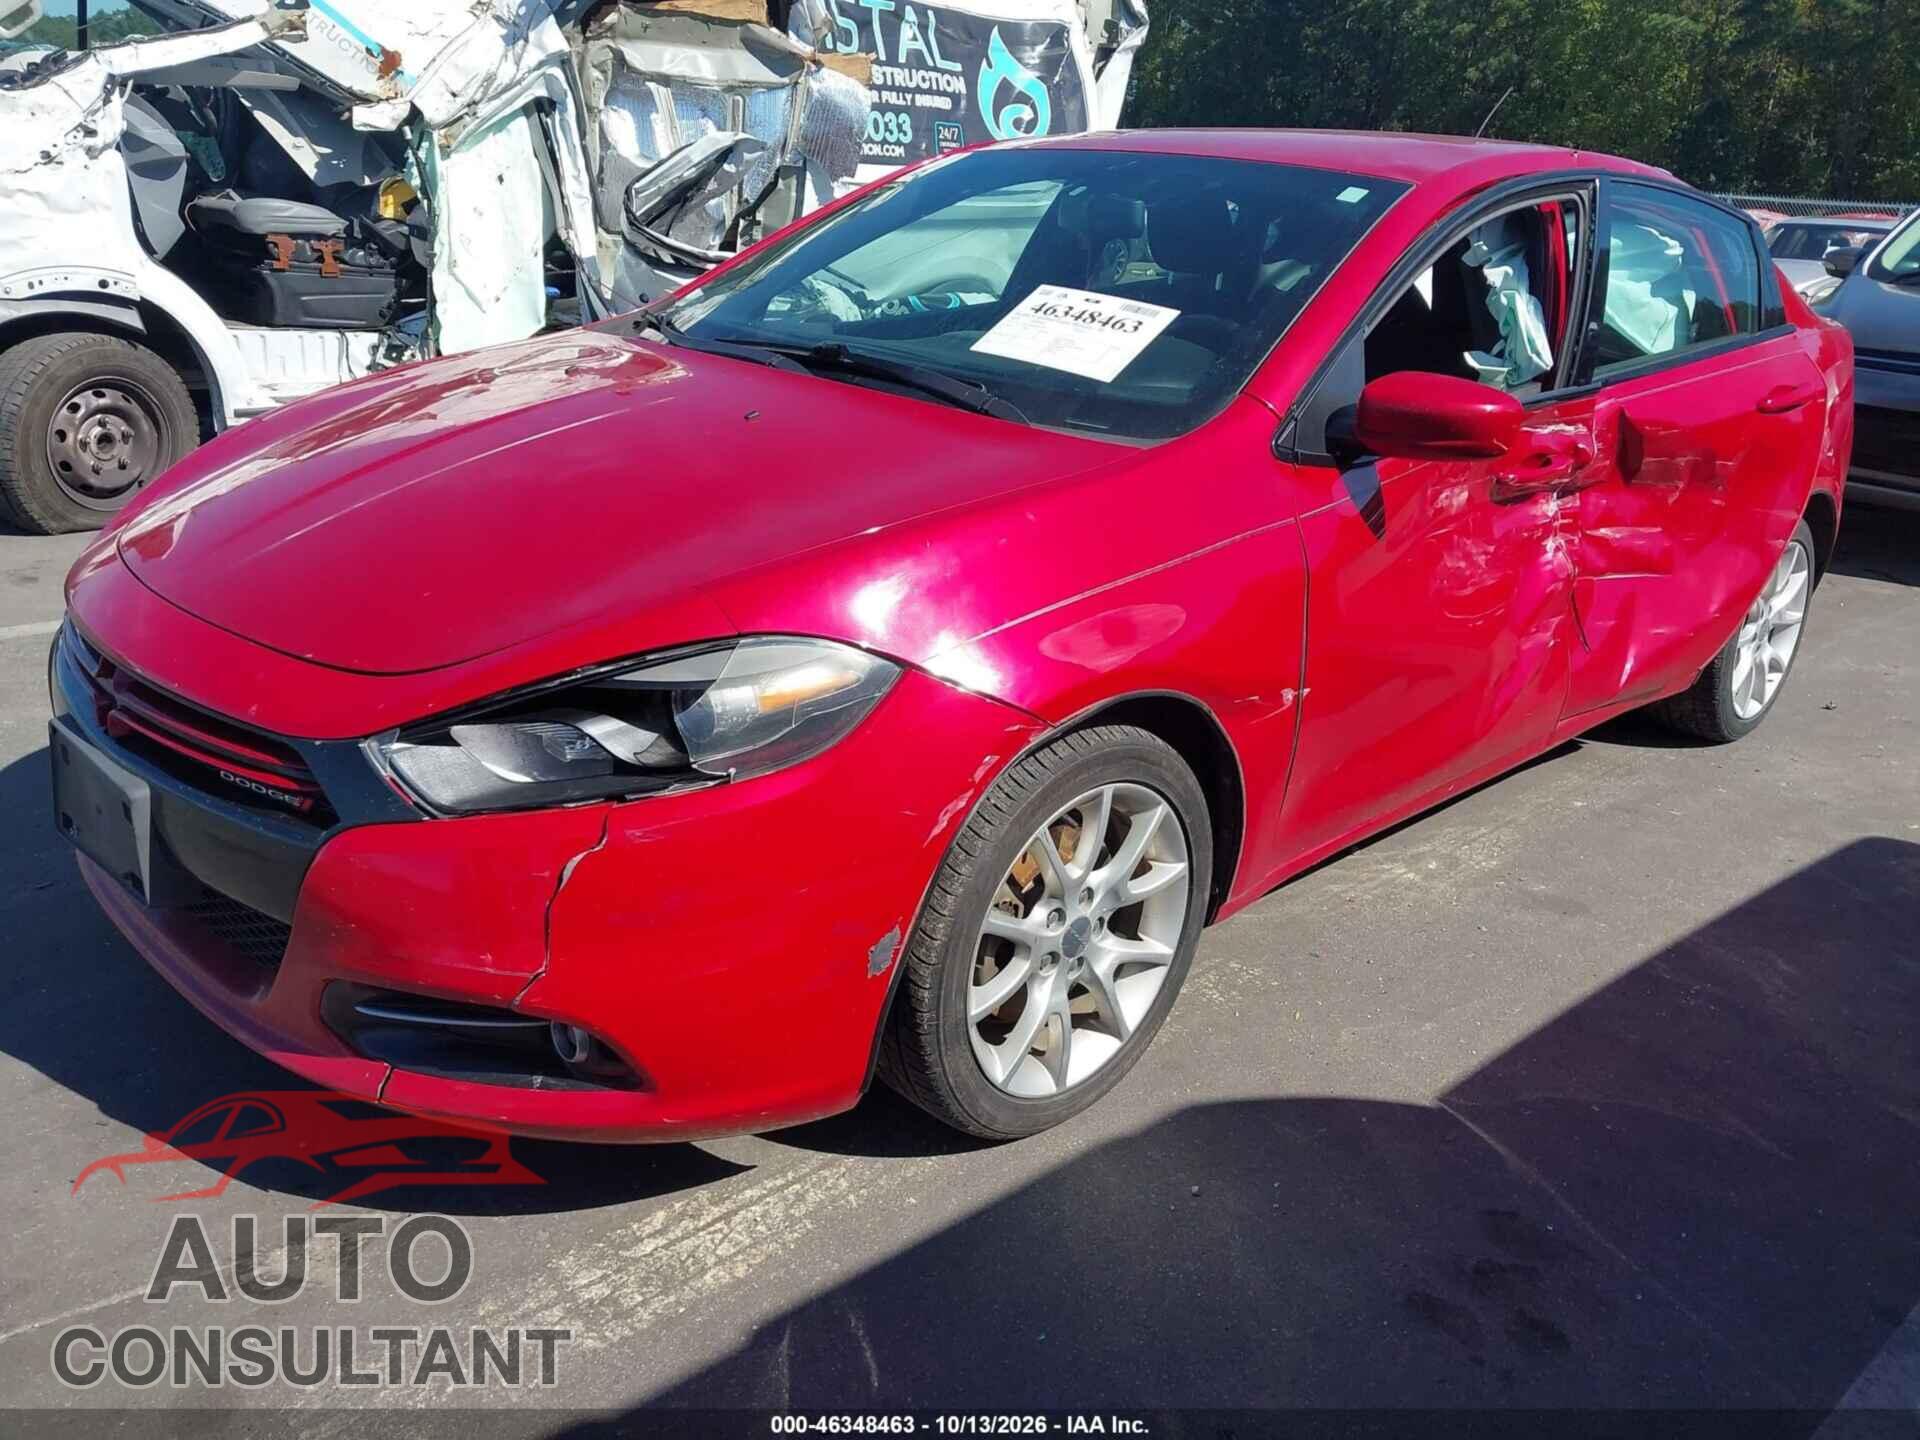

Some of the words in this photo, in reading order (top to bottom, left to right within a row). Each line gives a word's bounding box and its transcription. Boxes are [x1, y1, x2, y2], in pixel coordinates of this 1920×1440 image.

[881, 90, 913, 106] FULLY
[938, 126, 959, 141] 24/7
[1030, 301, 1144, 334] 46348463
[220, 770, 302, 807] DODGE
